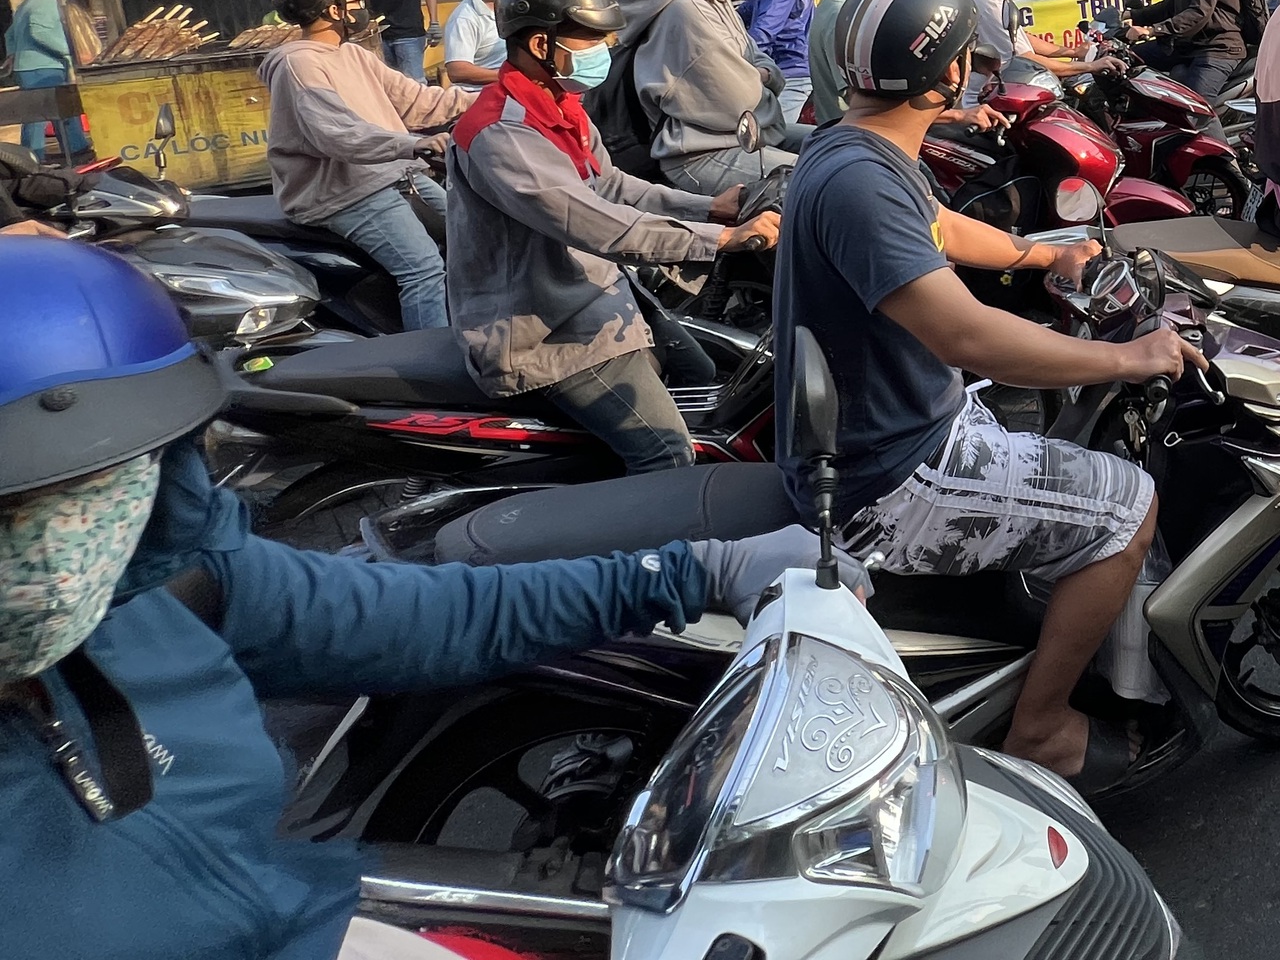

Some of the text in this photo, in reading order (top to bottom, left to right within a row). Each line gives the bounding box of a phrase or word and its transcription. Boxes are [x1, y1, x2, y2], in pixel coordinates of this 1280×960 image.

[909, 5, 955, 59] FILA
[171, 131, 232, 155] LÓC
[772, 655, 819, 773] VISION
